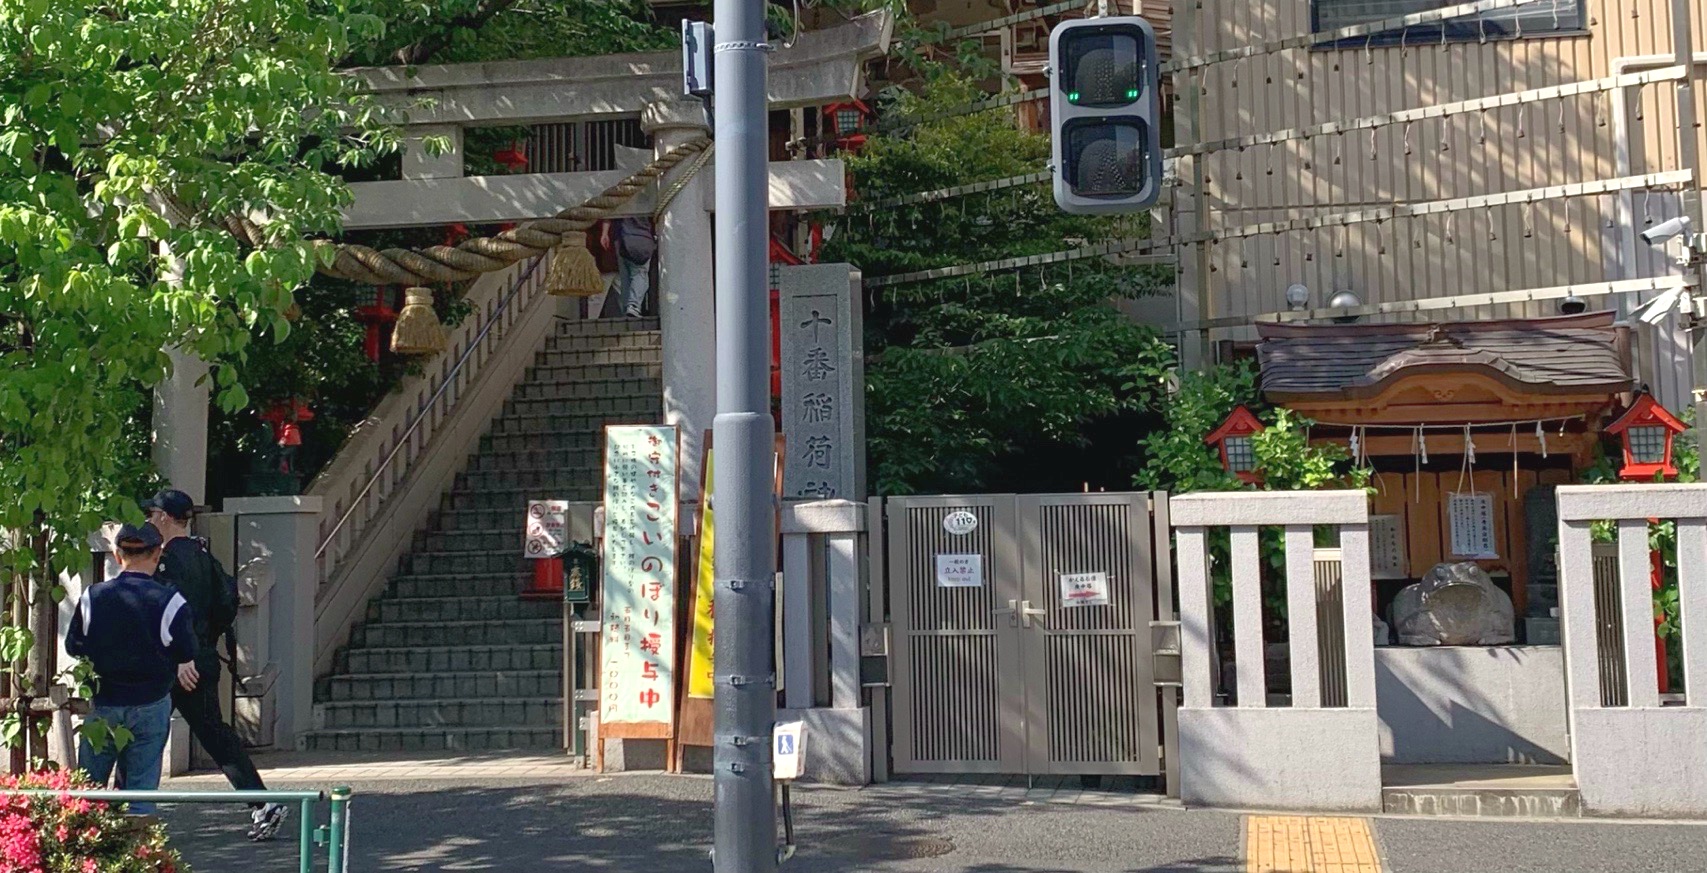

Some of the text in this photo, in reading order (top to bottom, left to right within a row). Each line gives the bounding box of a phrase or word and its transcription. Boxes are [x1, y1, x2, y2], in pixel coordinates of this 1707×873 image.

[640, 435, 662, 708] 御守付きこいのぼり授与中
[944, 566, 975, 575] 立入禁止
